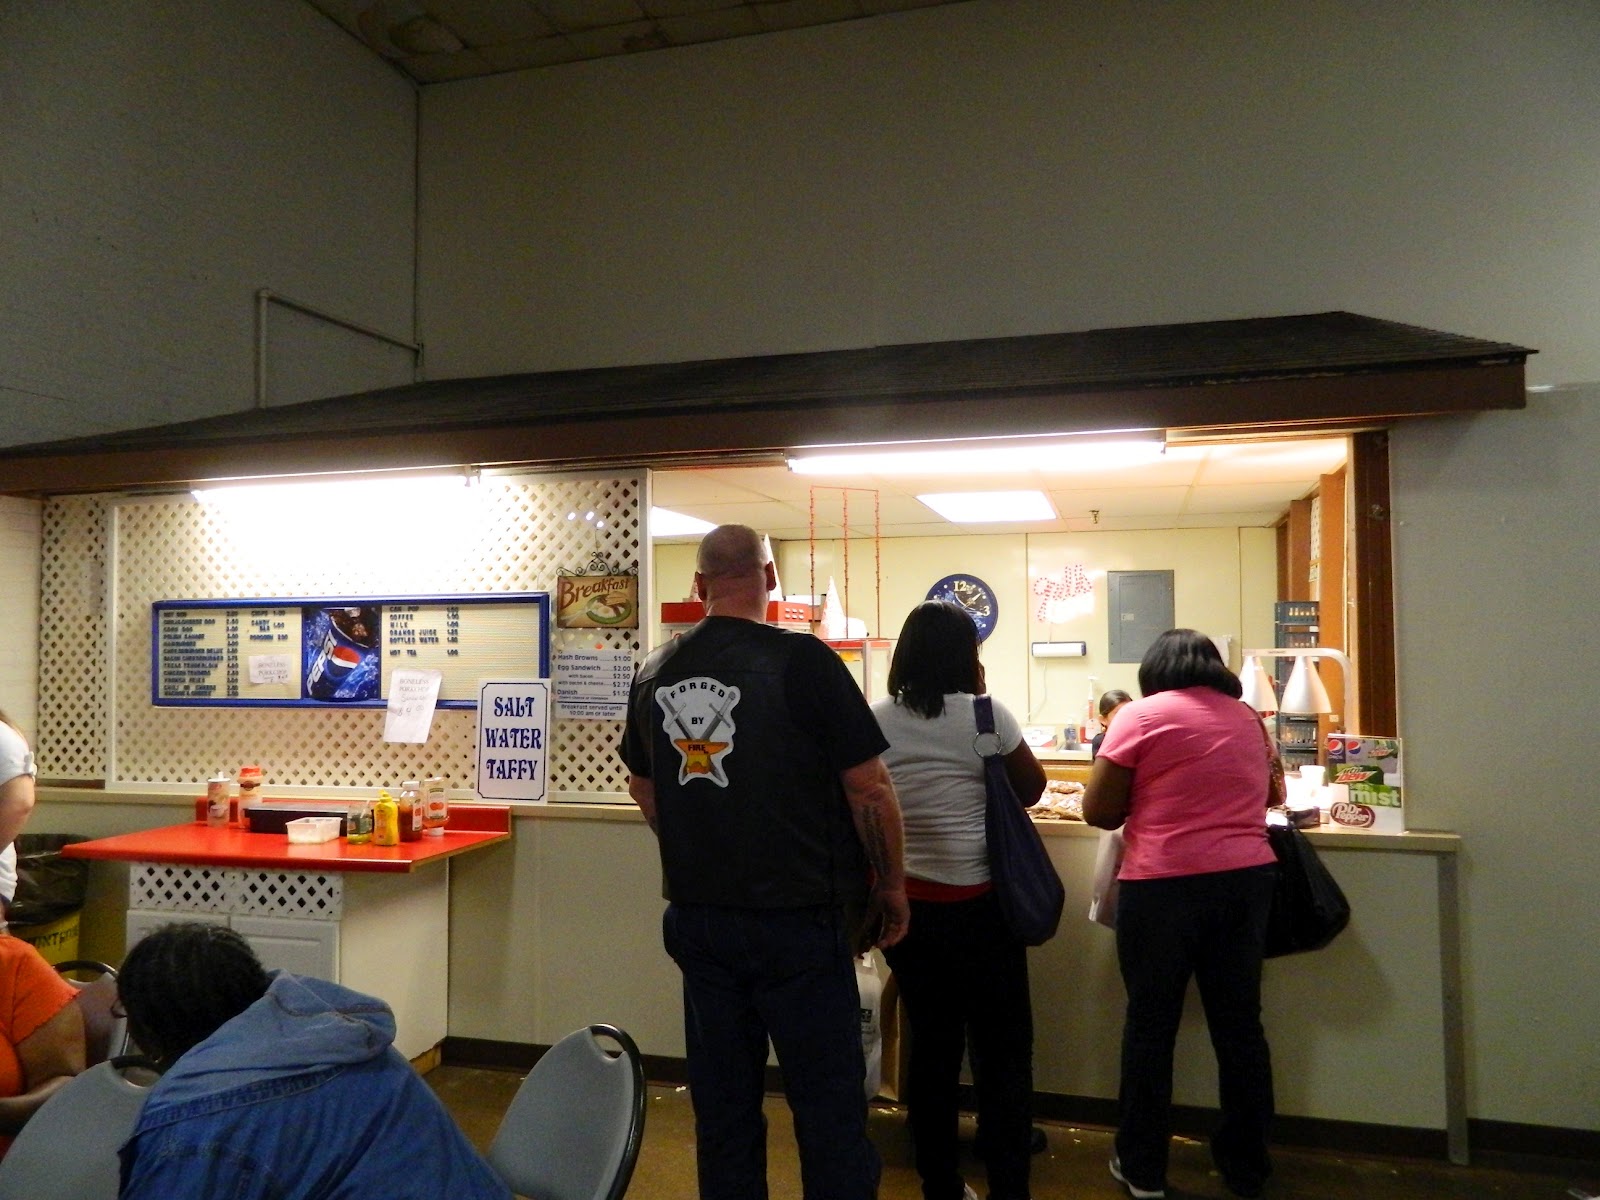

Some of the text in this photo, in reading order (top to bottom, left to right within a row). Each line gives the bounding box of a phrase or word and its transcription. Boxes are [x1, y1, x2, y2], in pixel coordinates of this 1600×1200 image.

[560, 577, 630, 611] Breakfast
[954, 580, 967, 592] 12
[306, 628, 338, 696] PEPSI
[670, 681, 725, 699] FORGED
[493, 696, 535, 718] SALT
[691, 716, 705, 725] BY
[484, 727, 542, 750] WATER
[687, 743, 706, 752] FIRE
[485, 758, 538, 781] TAFFY
[1349, 789, 1400, 807] mist
[1335, 804, 1369, 823] Pepper
[1349, 803, 1363, 815] Dr
